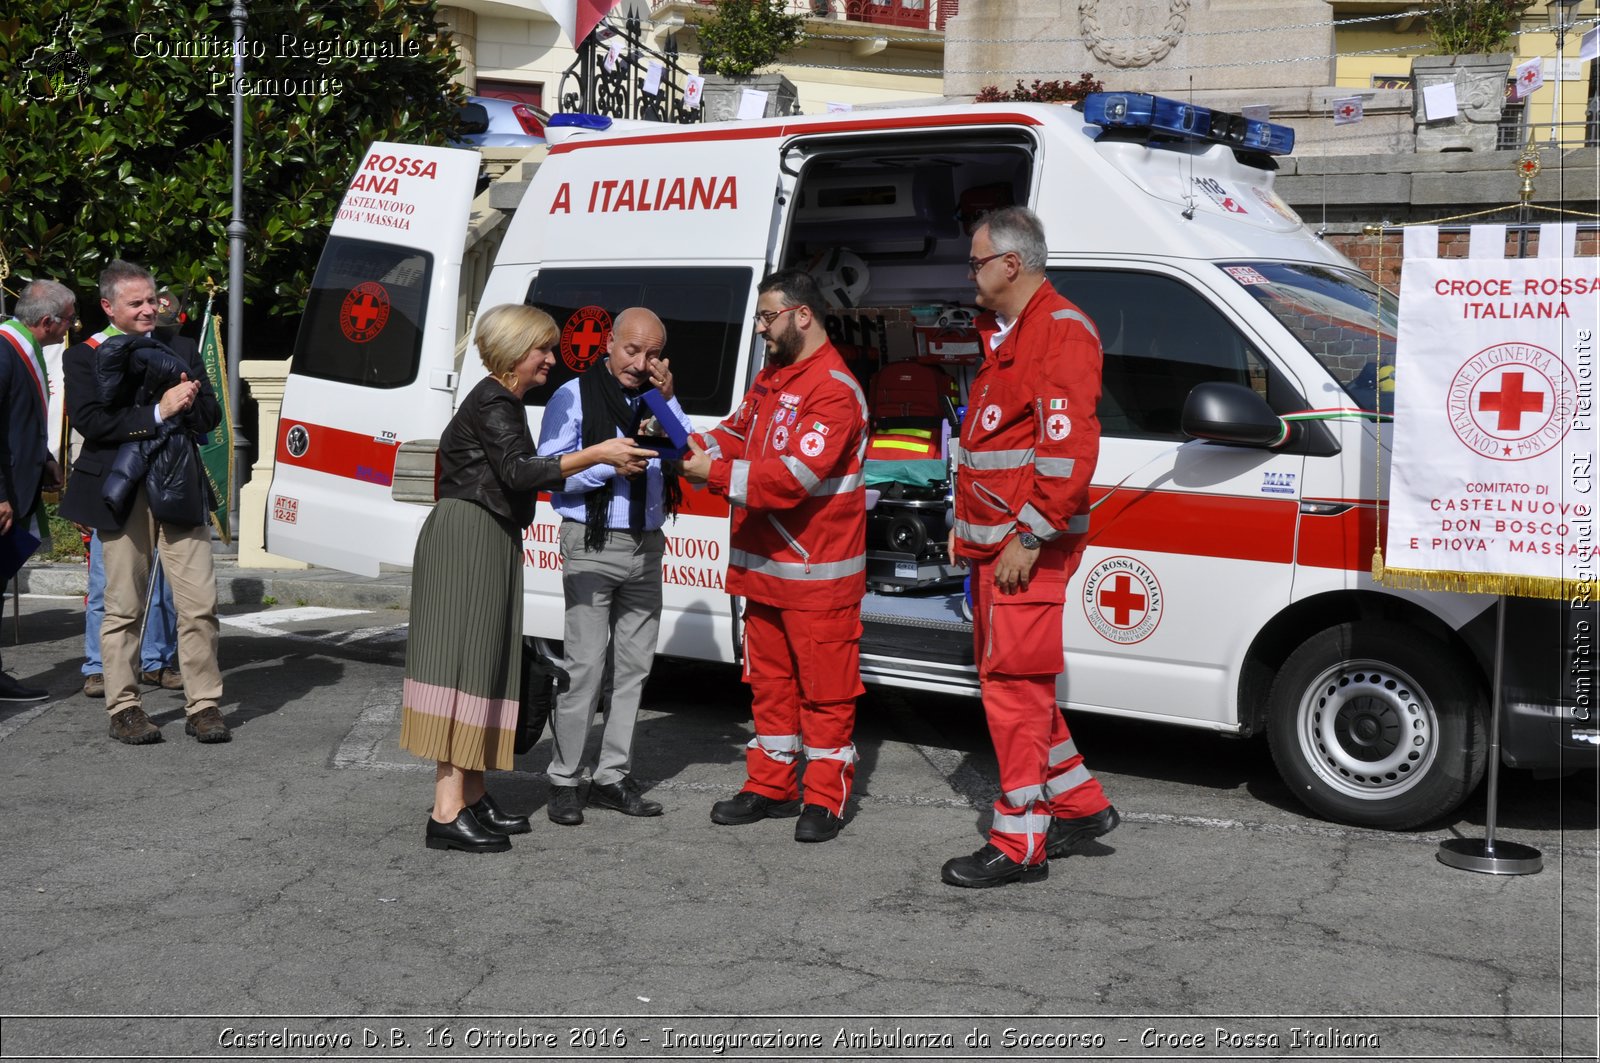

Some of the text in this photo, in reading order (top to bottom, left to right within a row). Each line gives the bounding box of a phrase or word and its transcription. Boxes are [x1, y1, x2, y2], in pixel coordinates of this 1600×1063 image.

[364, 154, 438, 180] ROSSA
[350, 173, 400, 196] ANA
[342, 195, 415, 215] ASTELNUOVO
[549, 176, 738, 215] A ITALIANA
[364, 212, 410, 231] MASSAIA
[1435, 277, 1600, 296] CROCE ROSSA
[1463, 301, 1571, 319] ITALIANA
[1469, 357, 1488, 374] DI
[1487, 346, 1552, 372] GINEVRA
[1451, 371, 1499, 455] CONVENZIONE
[1543, 388, 1573, 440] AGOSTO
[381, 430, 397, 440] TDI
[1517, 434, 1546, 455] 1864
[1466, 482, 1549, 495] COMITATO DI
[276, 497, 297, 510] AT 14
[1430, 498, 1587, 516] CASTELNUOVO
[274, 509, 296, 522] 12-25
[1442, 519, 1569, 537] DON BOSCO
[663, 536, 720, 561] NUOVO
[1410, 537, 1419, 549] E
[1086, 560, 1160, 612] CROCE ROSSA ITALIANA
